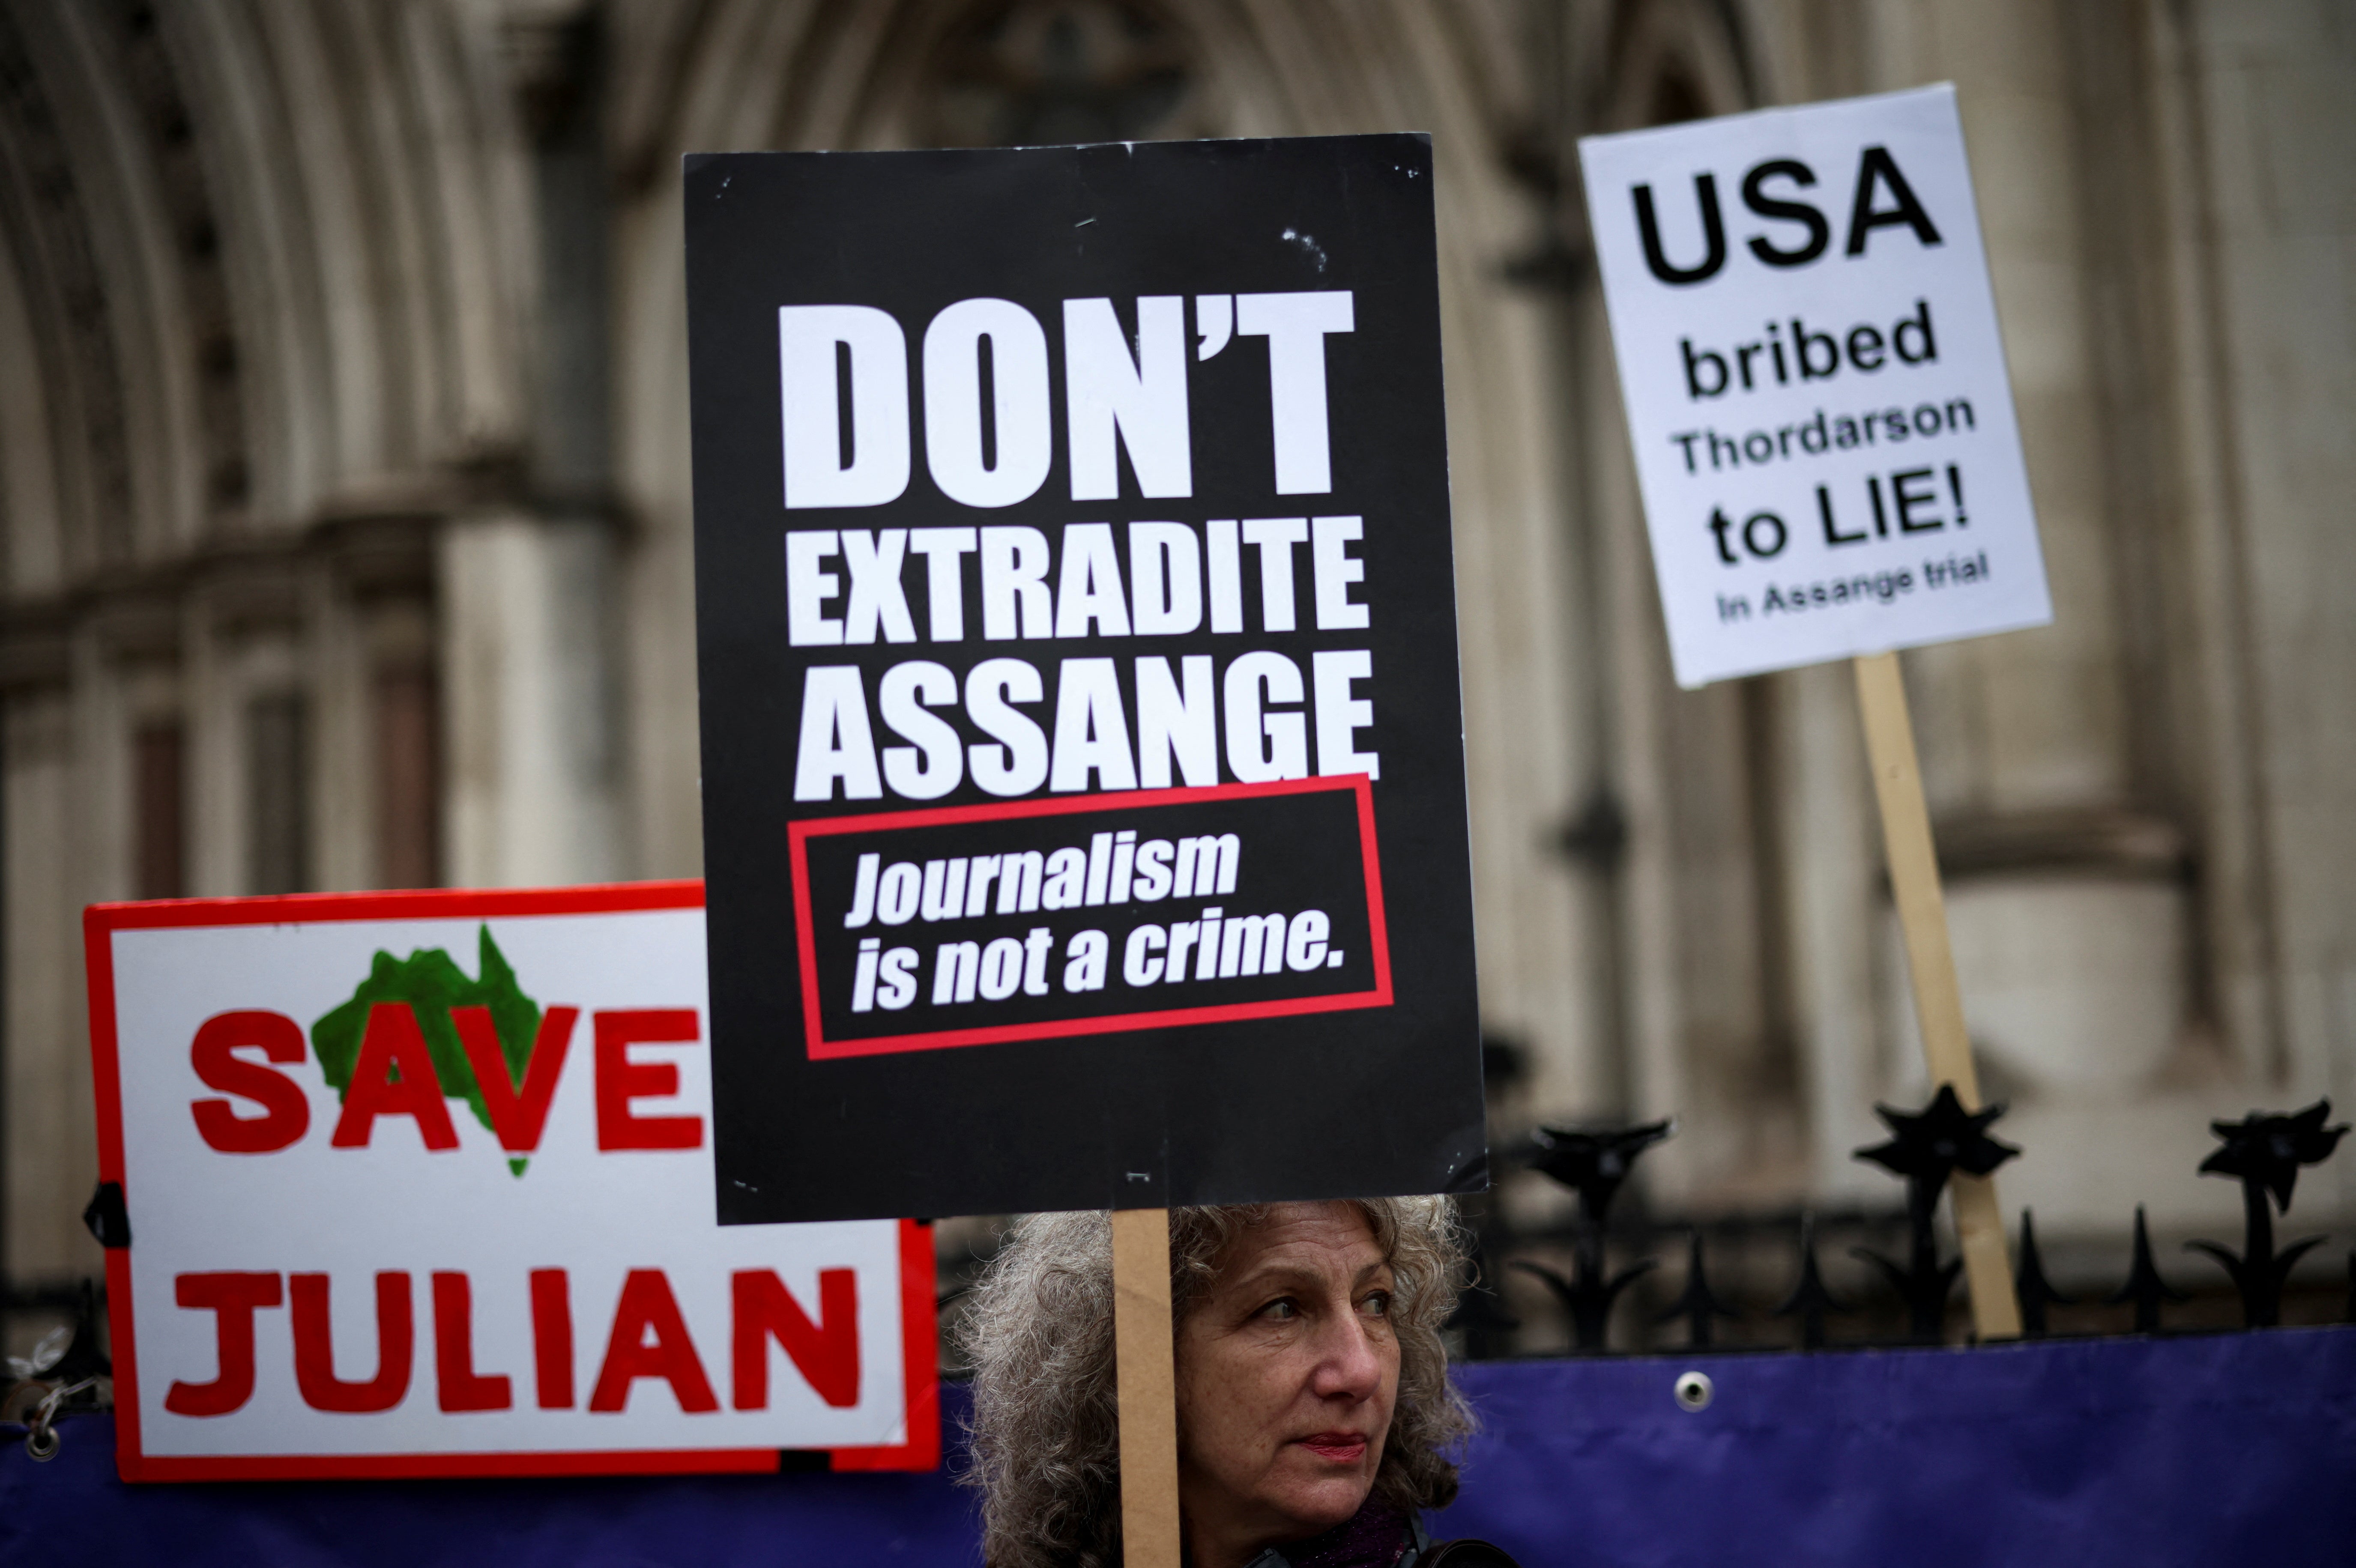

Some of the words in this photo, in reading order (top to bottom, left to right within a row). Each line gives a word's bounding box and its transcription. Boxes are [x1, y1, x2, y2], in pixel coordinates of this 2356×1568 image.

[1630, 144, 1944, 287] USA
[780, 291, 1354, 508] DON'T
[1680, 299, 1938, 400] bribed
[1673, 398, 1976, 475] Thordarson
[1707, 505, 1789, 566] to
[1816, 463, 1968, 547] LIE!
[786, 516, 1369, 646] EXTRADITE
[1717, 592, 1752, 624] In
[1763, 570, 1914, 611] Assange
[1924, 551, 1990, 587] trial
[794, 650, 1379, 801] ASSANGE
[845, 830, 1240, 927] Journalism
[852, 938, 918, 1012] is
[933, 928, 1053, 1004] not
[1064, 930, 1108, 992] a
[1124, 908, 1343, 986] crime.
[191, 1003, 704, 1153] SAVE
[166, 1268, 860, 1416] JULIAN
